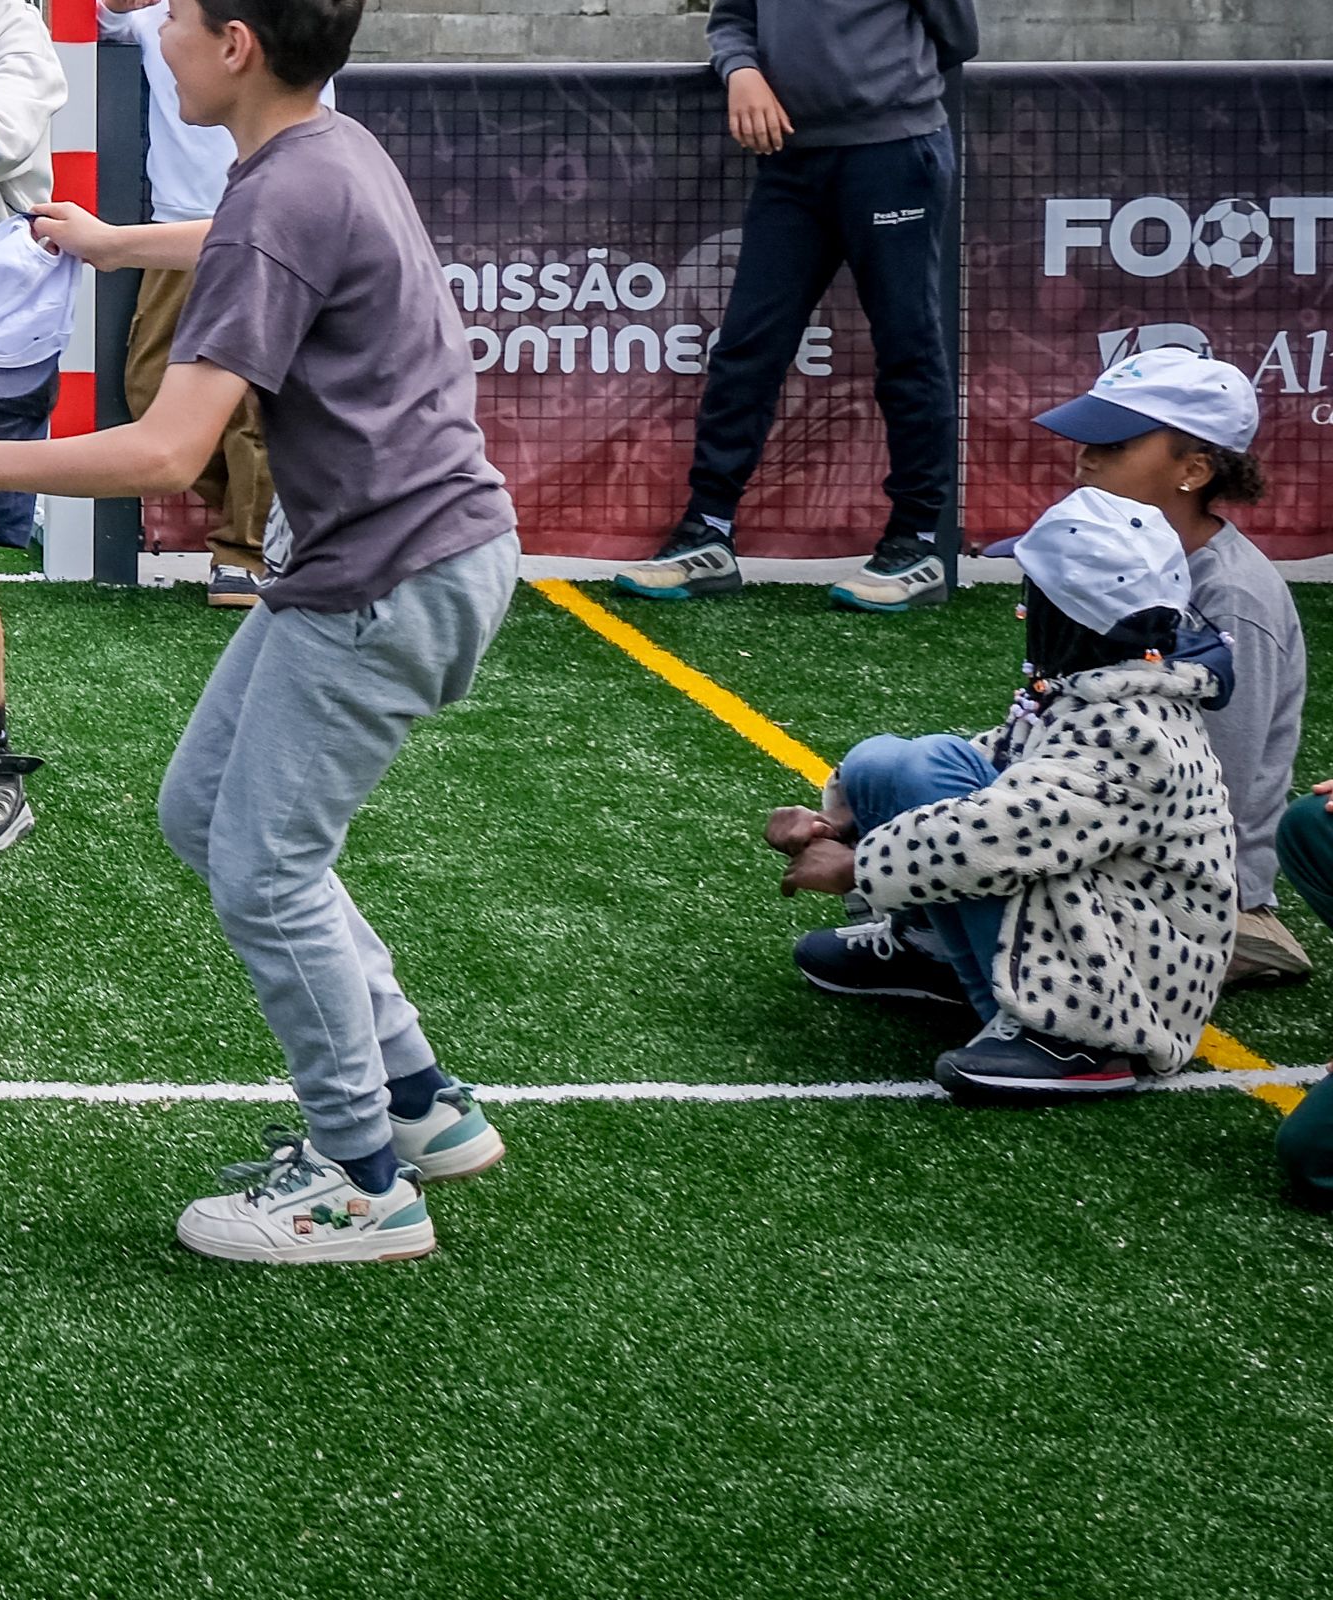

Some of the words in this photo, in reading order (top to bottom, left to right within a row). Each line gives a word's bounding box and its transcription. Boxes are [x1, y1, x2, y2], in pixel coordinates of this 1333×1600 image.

[441, 247, 667, 312] MISSÃO
[462, 323, 833, 377] ONTINEE
[1253, 330, 1333, 394] Al
